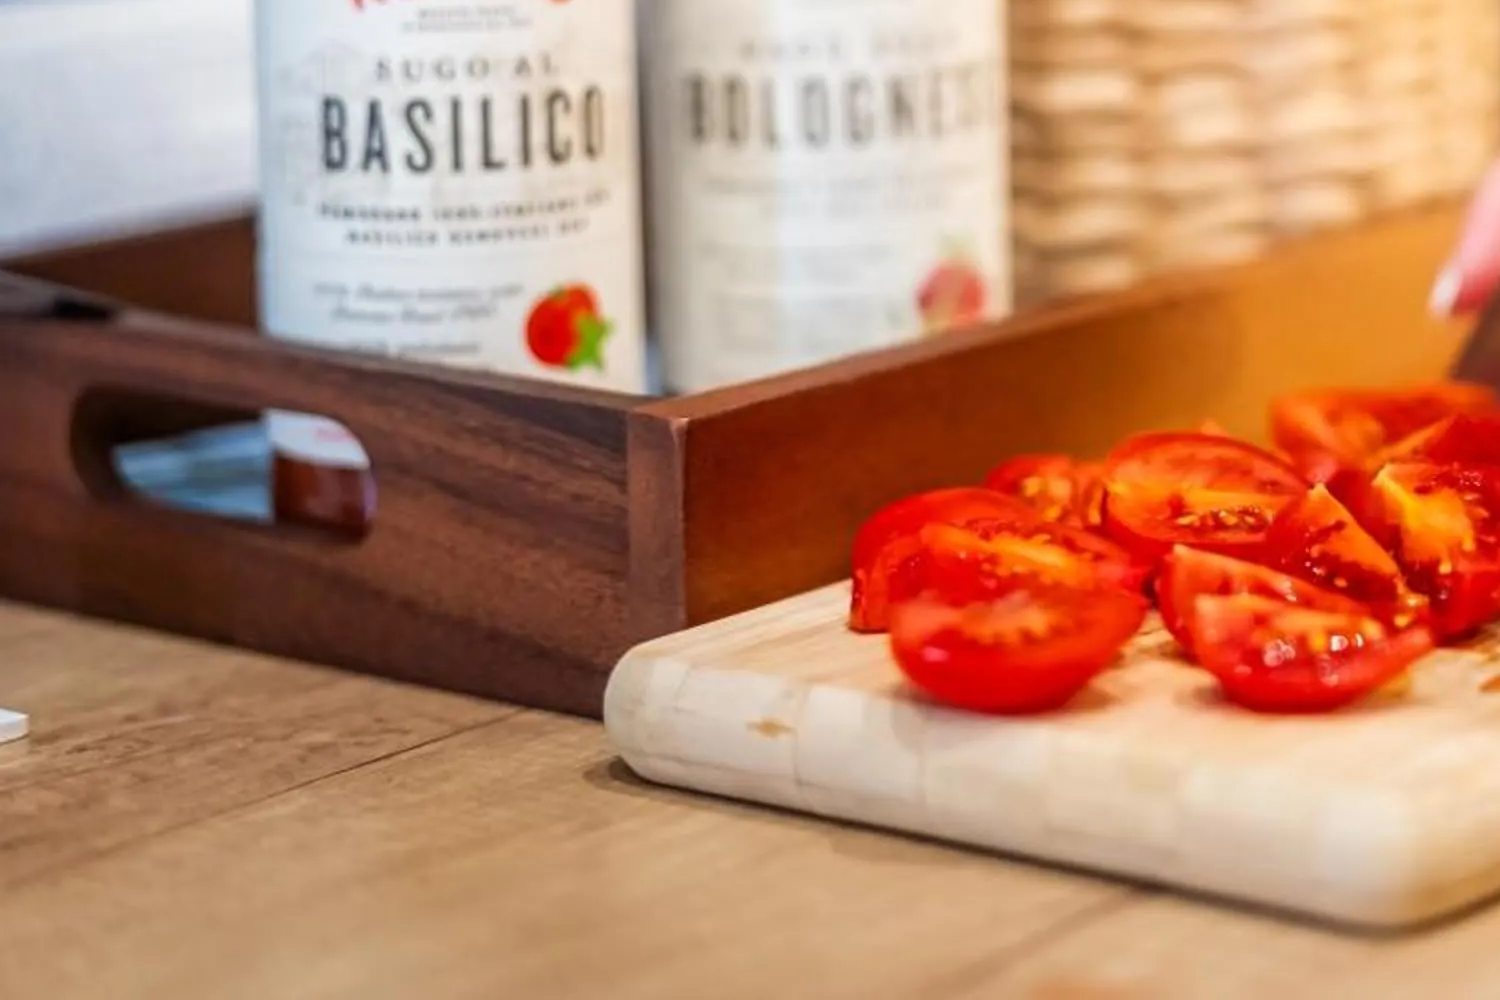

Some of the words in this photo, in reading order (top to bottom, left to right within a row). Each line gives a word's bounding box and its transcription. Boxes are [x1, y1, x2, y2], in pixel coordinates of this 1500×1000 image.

[375, 52, 492, 83] SUGO
[514, 51, 558, 78] AL
[320, 84, 605, 174] BASILICO
